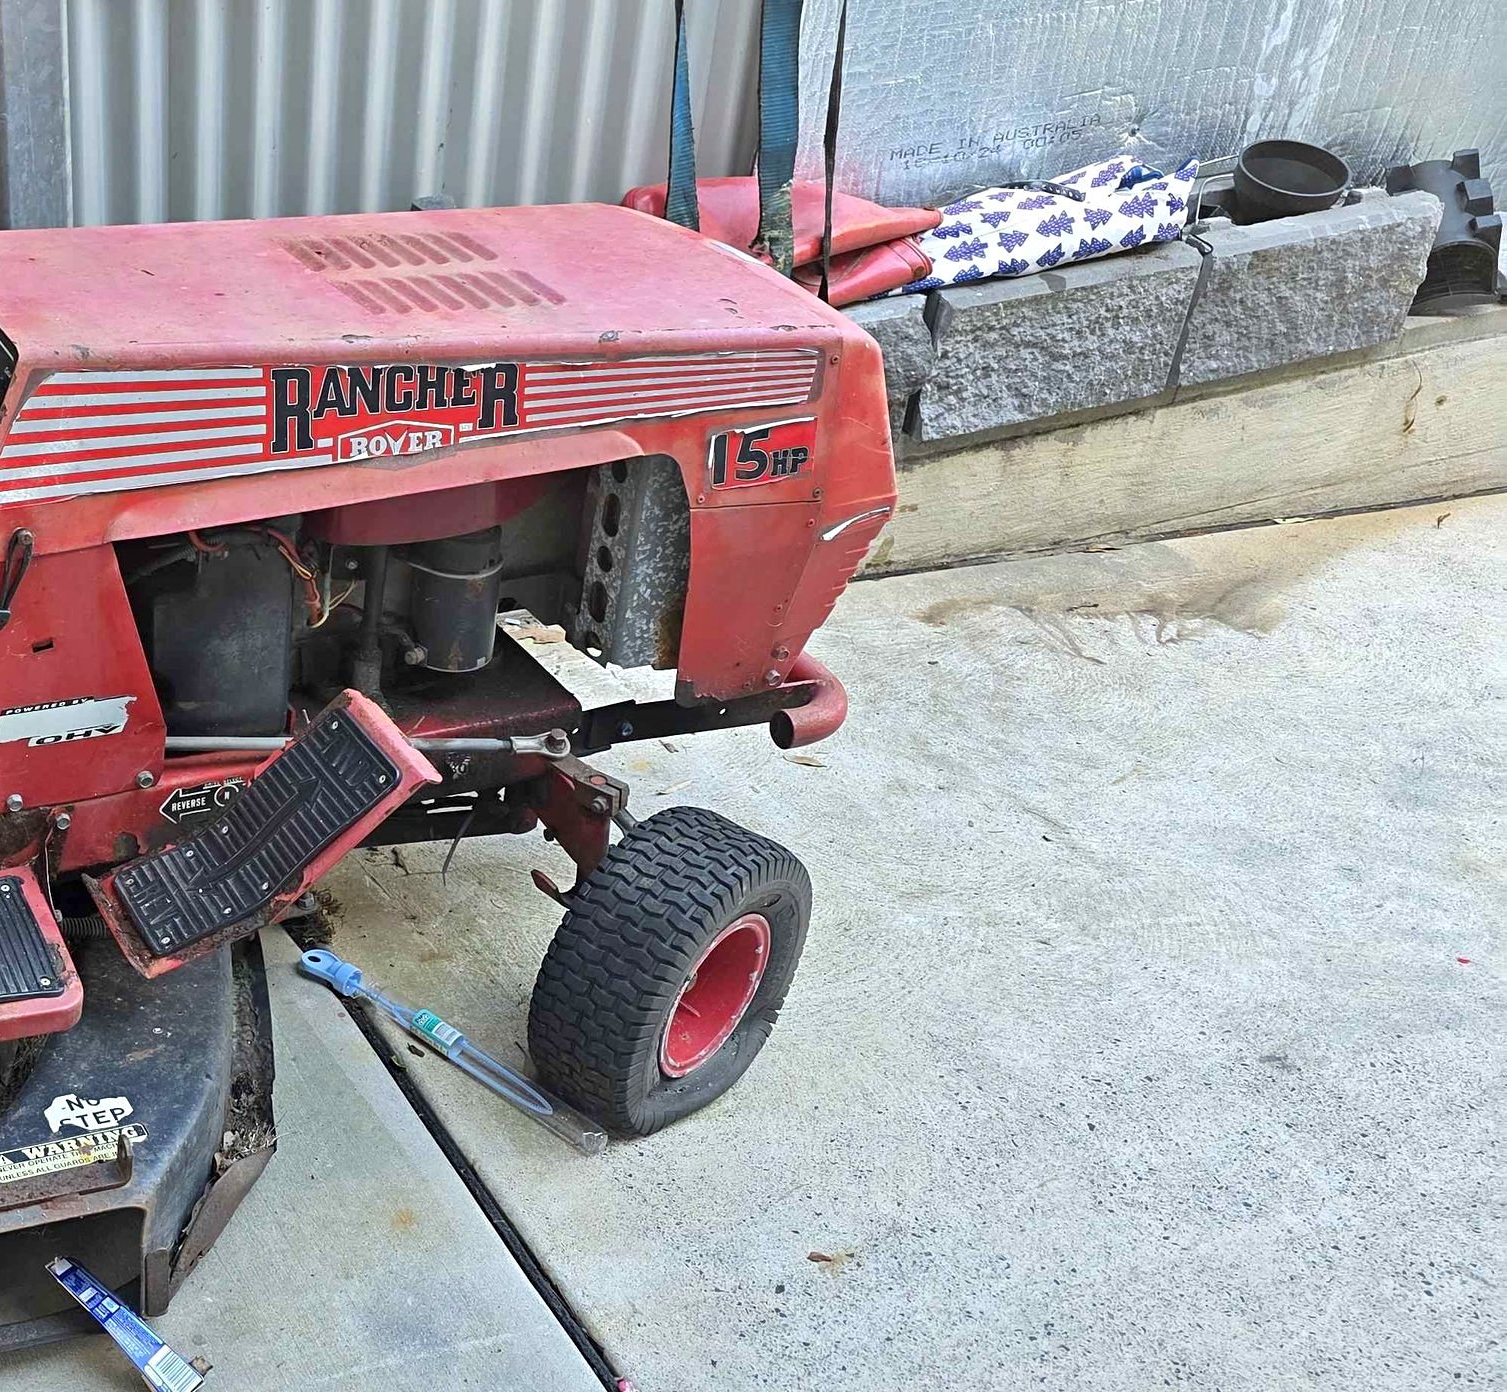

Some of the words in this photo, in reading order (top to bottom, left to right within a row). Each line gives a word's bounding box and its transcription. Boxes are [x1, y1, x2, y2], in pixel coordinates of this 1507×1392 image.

[890, 142, 942, 160] MADE
[959, 138, 980, 150] IN
[993, 113, 1101, 142] AUSTRALIA
[271, 362, 519, 453] RANCHER
[349, 429, 443, 457] ROVER
[713, 428, 770, 485] 15
[770, 447, 810, 476] HP
[5, 701, 66, 715] POWERED
[72, 697, 89, 705] BY
[171, 796, 206, 812] REVERSE
[22, 1126, 136, 1160] WARNING
[0, 1169, 35, 1181] UNLESS
[36, 1164, 53, 1174] ALL
[53, 1156, 92, 1169] GUARDS
[27, 1153, 71, 1167] OPERATE
